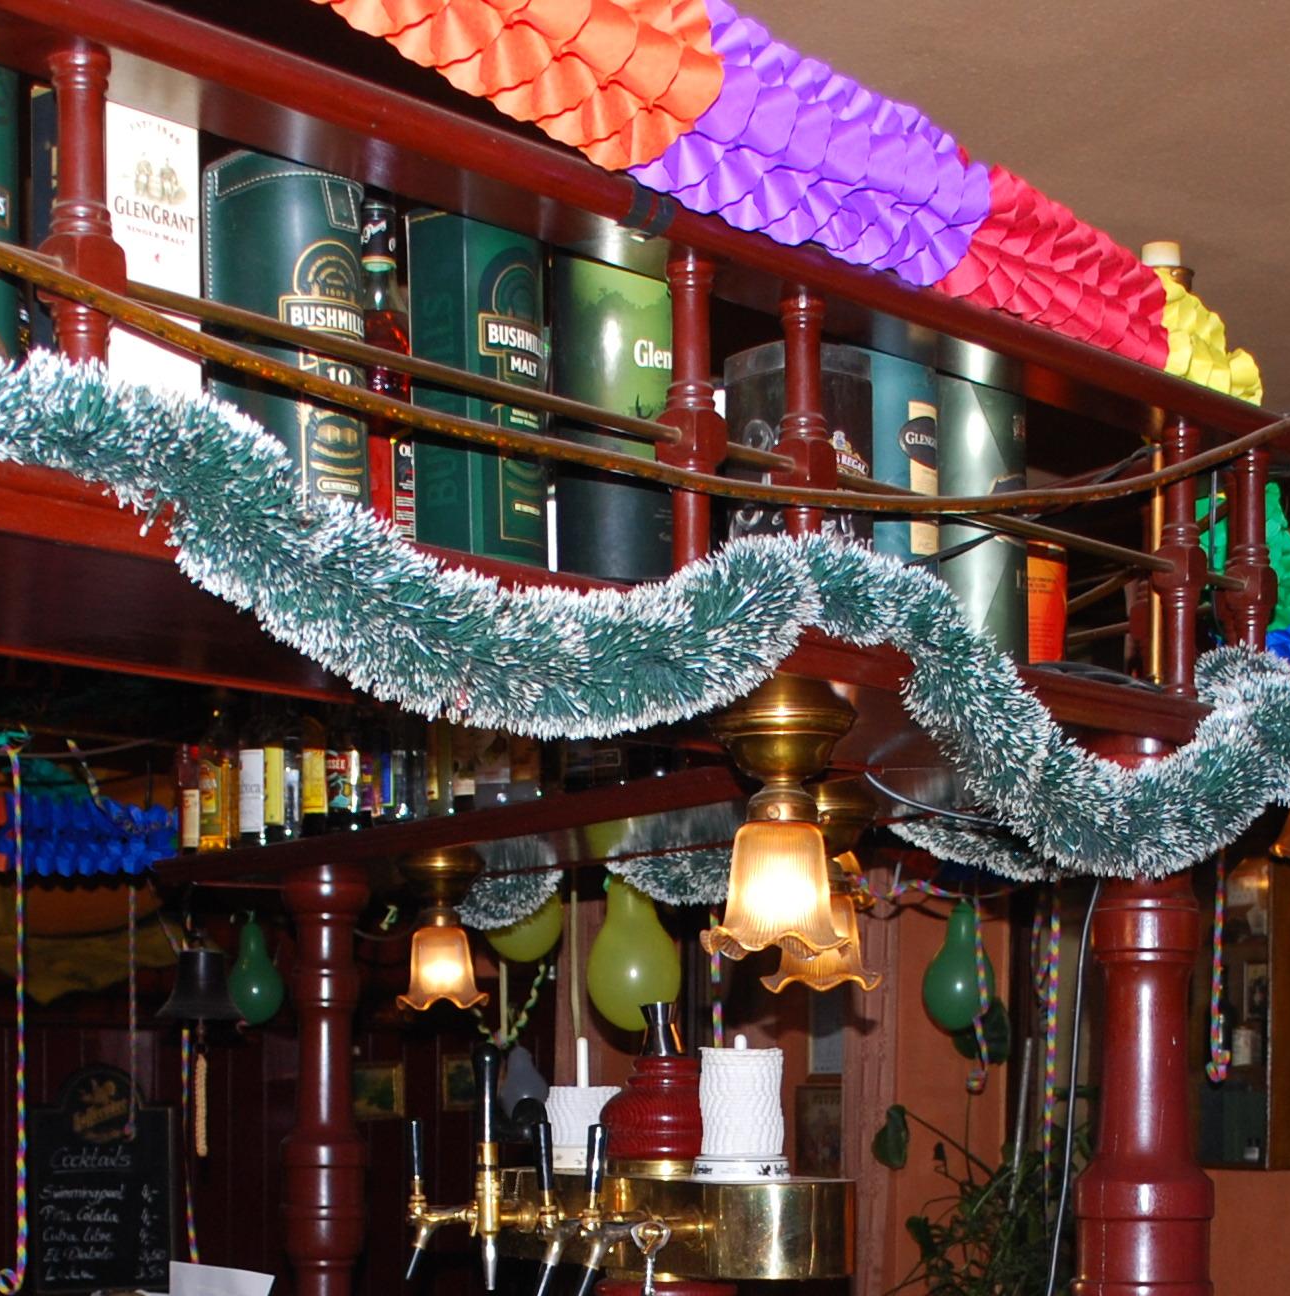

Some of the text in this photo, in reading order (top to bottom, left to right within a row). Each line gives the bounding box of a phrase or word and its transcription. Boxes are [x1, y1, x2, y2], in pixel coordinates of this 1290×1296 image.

[289, 303, 366, 341] BUSHMILLS
[510, 355, 538, 378] MALT
[633, 338, 673, 371] Glen
[326, 366, 352, 387] 10
[50, 1145, 132, 1171] Cocktails
